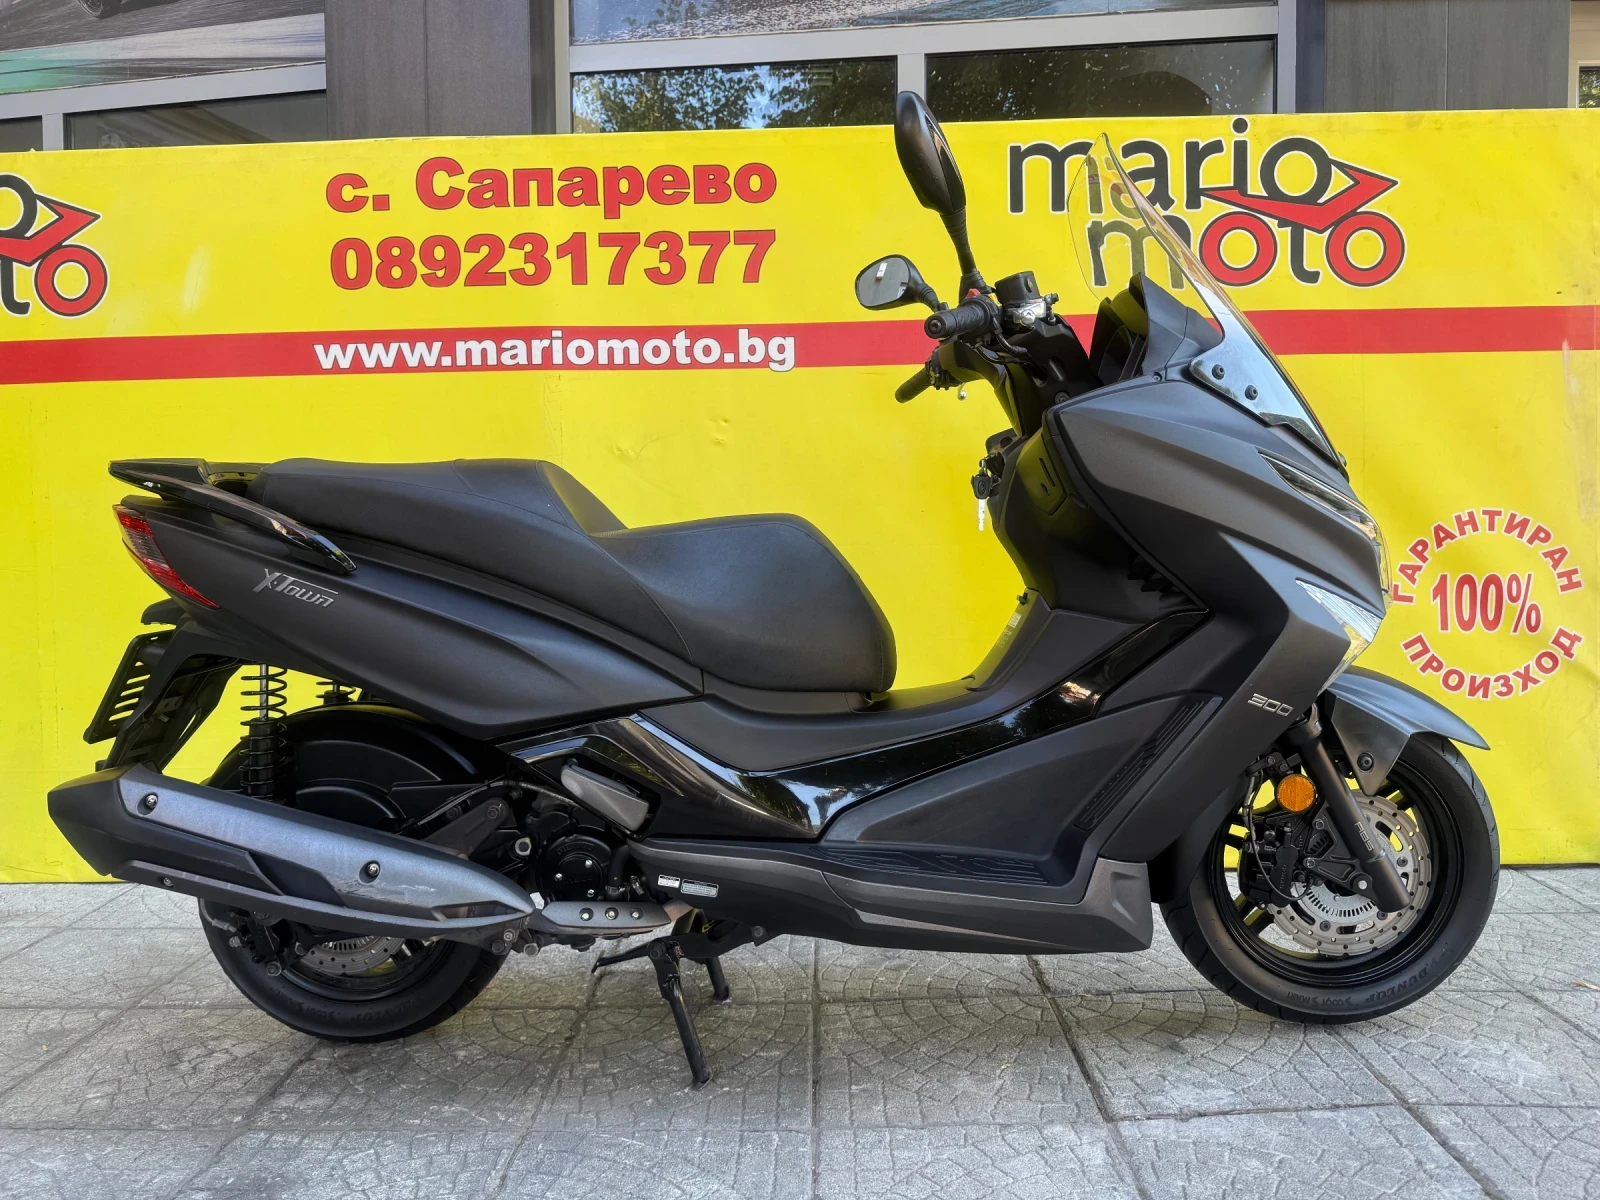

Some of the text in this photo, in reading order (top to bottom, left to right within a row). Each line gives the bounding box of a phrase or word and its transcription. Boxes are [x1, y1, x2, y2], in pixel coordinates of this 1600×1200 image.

[416, 157, 777, 220] Сапарево
[1008, 117, 1332, 215] mario
[330, 229, 776, 291] 0892317377
[1086, 211, 1406, 289] moto
[313, 328, 796, 372] www.mariomoto.bg
[1392, 509, 1583, 604] ГАРАНТИРАН
[1431, 573, 1542, 634] 100%
[1402, 627, 1583, 699] ПРОИЗХОД
[1247, 693, 1294, 717] 300
[1354, 821, 1375, 852] ABS
[1364, 965, 1429, 1001] DUNLOP
